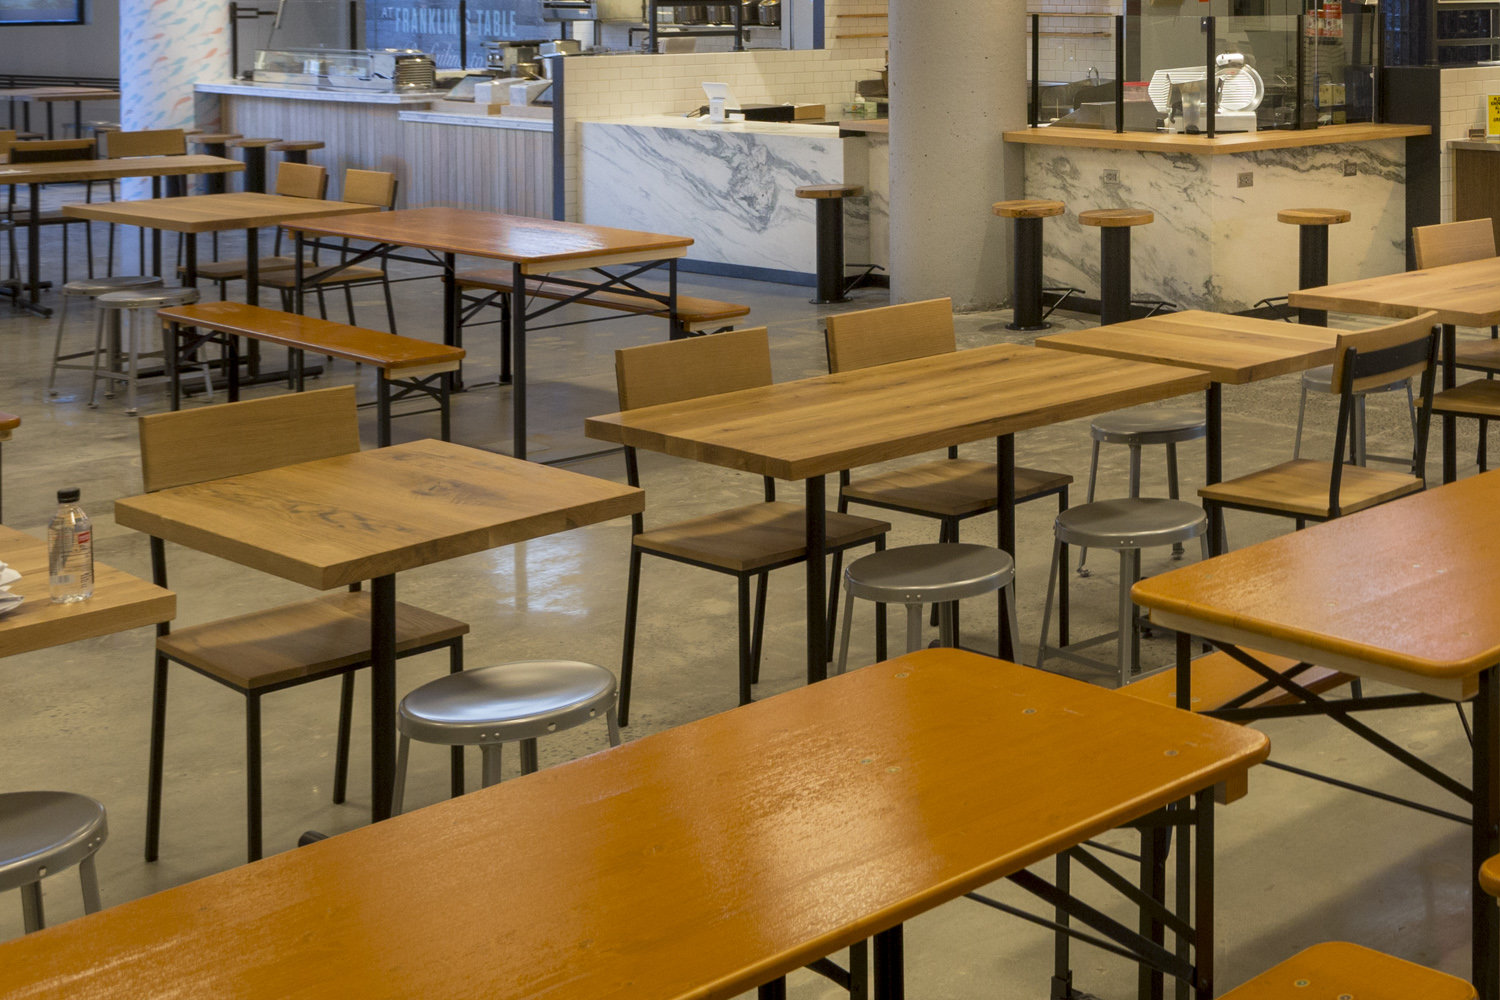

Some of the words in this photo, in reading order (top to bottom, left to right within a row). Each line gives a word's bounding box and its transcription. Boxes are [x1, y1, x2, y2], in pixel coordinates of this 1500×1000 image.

[381, 7, 394, 18] AT
[395, 8, 471, 36] FRANKLINS
[476, 10, 516, 37] TABLE
